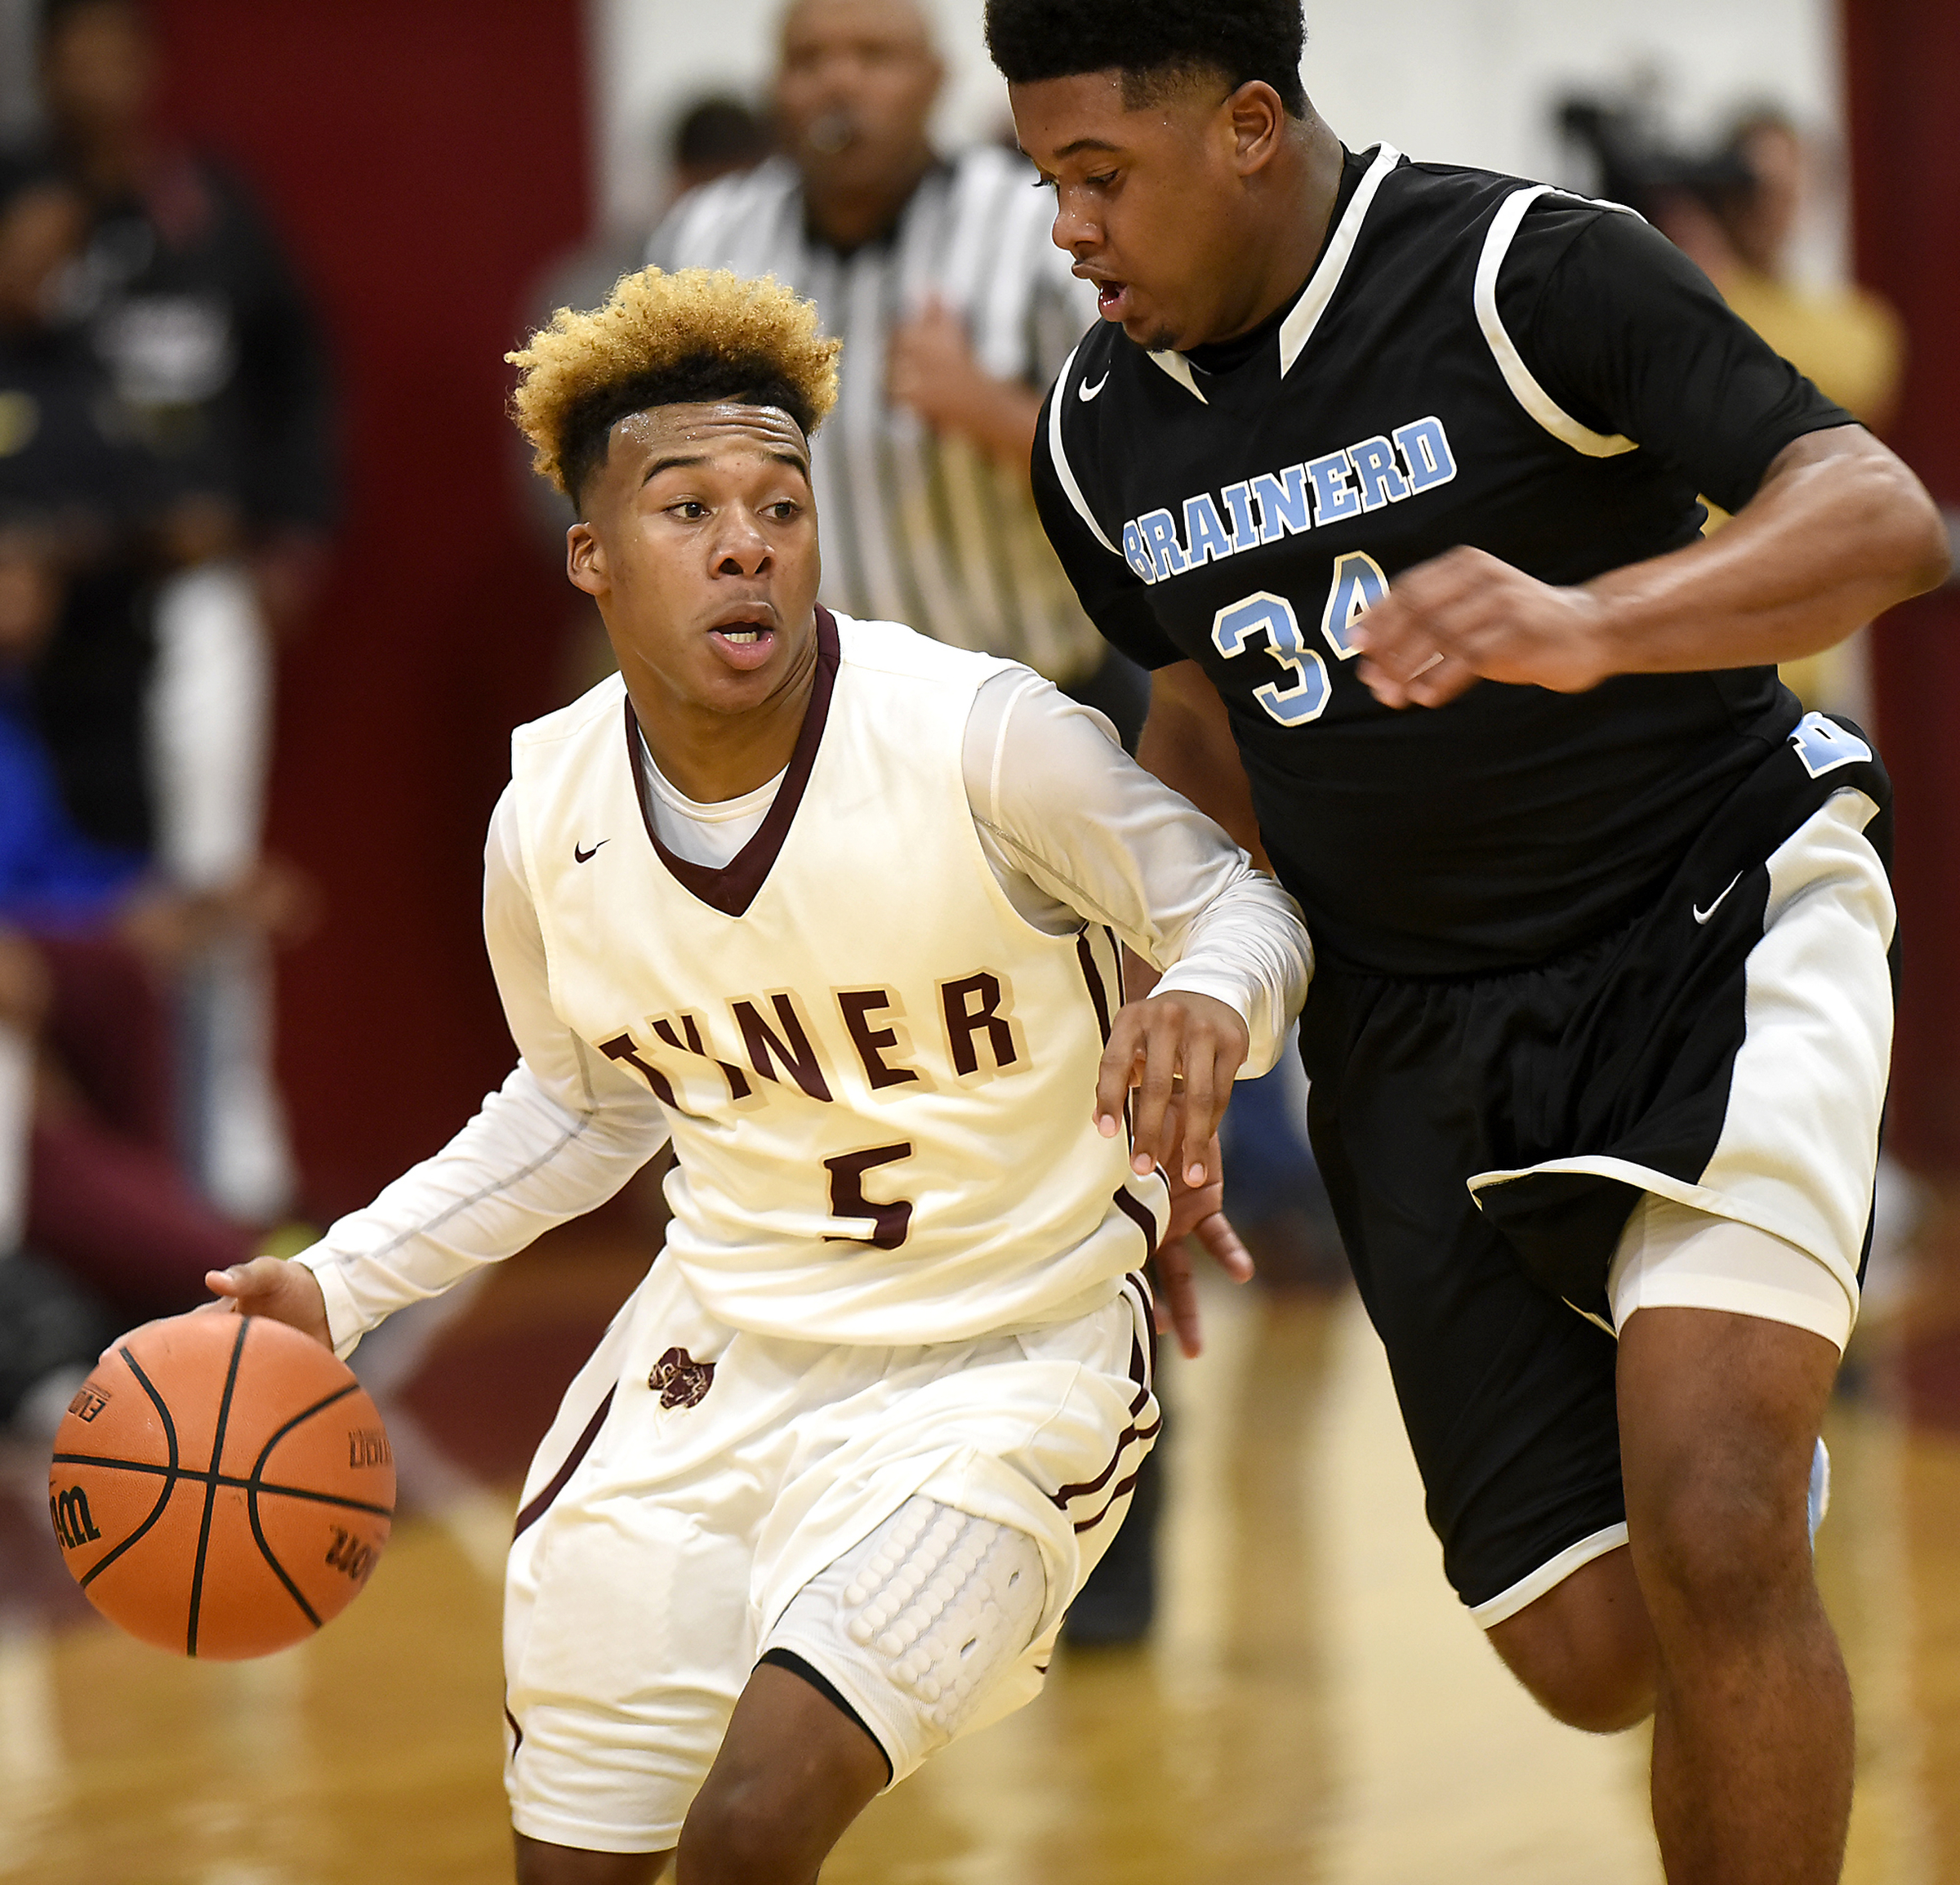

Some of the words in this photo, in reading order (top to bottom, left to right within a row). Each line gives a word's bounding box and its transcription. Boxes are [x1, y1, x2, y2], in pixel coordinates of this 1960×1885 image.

[1122, 415, 1457, 585] BRAINERD
[597, 967, 1031, 1121] TYNER
[822, 1141, 914, 1251] 5
